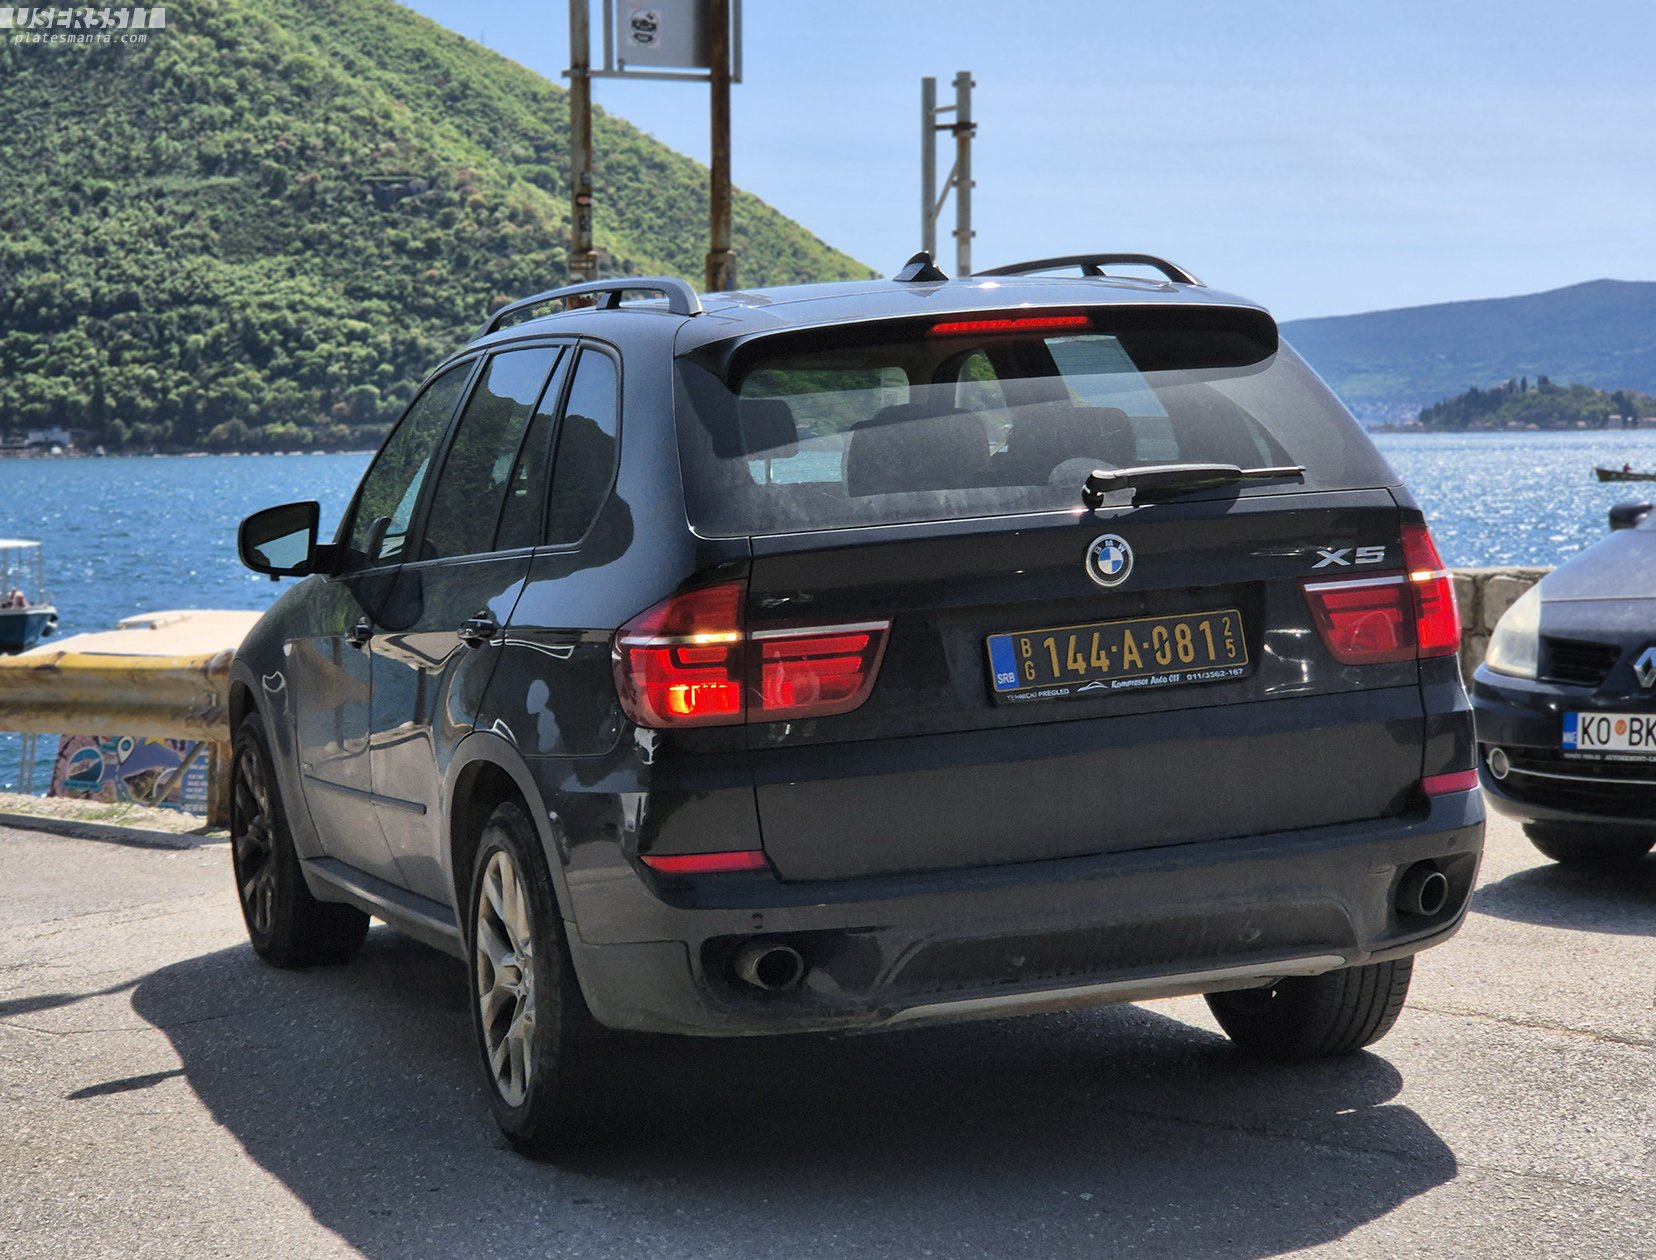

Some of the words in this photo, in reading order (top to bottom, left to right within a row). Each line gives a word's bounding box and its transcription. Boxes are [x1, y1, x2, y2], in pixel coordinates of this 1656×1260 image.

[1095, 540, 1126, 554] BMW
[1312, 545, 1387, 569] X5
[997, 672, 1015, 684] SRB
[1150, 676, 1167, 685] Auto
[1038, 688, 1069, 697] PREGLED
[1581, 716, 1611, 745] KO
[1629, 717, 1656, 746] BK
